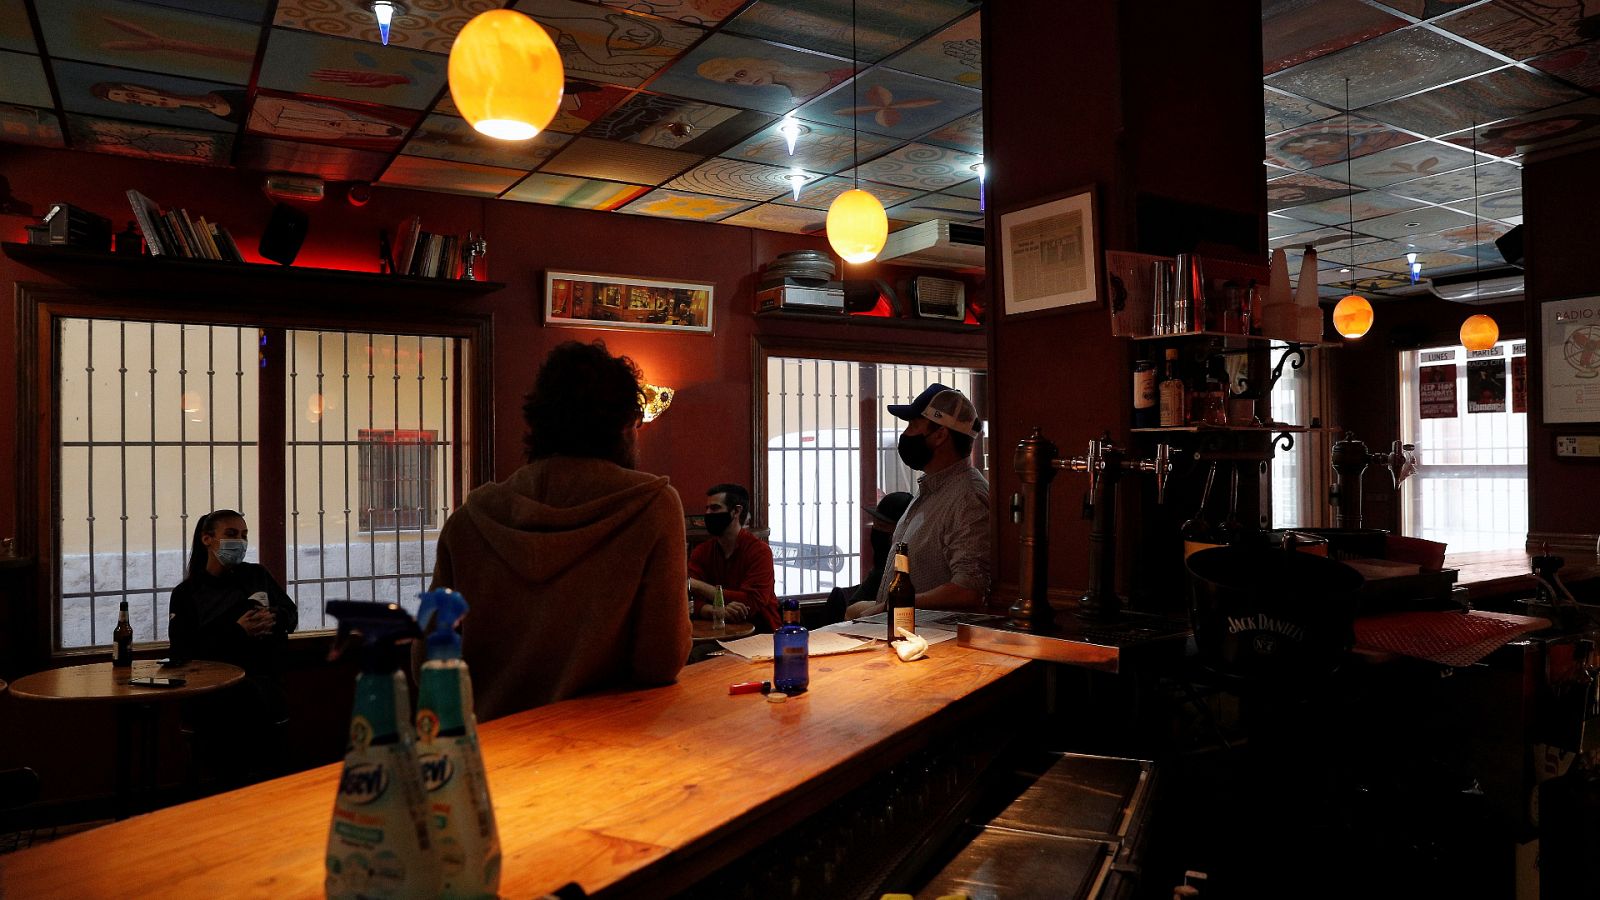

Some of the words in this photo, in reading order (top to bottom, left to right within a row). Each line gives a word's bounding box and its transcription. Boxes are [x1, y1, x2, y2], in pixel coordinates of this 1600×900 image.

[1555, 308, 1594, 321] RADIO
[1428, 353, 1448, 361] LUNES
[1227, 615, 1257, 634] JACK
